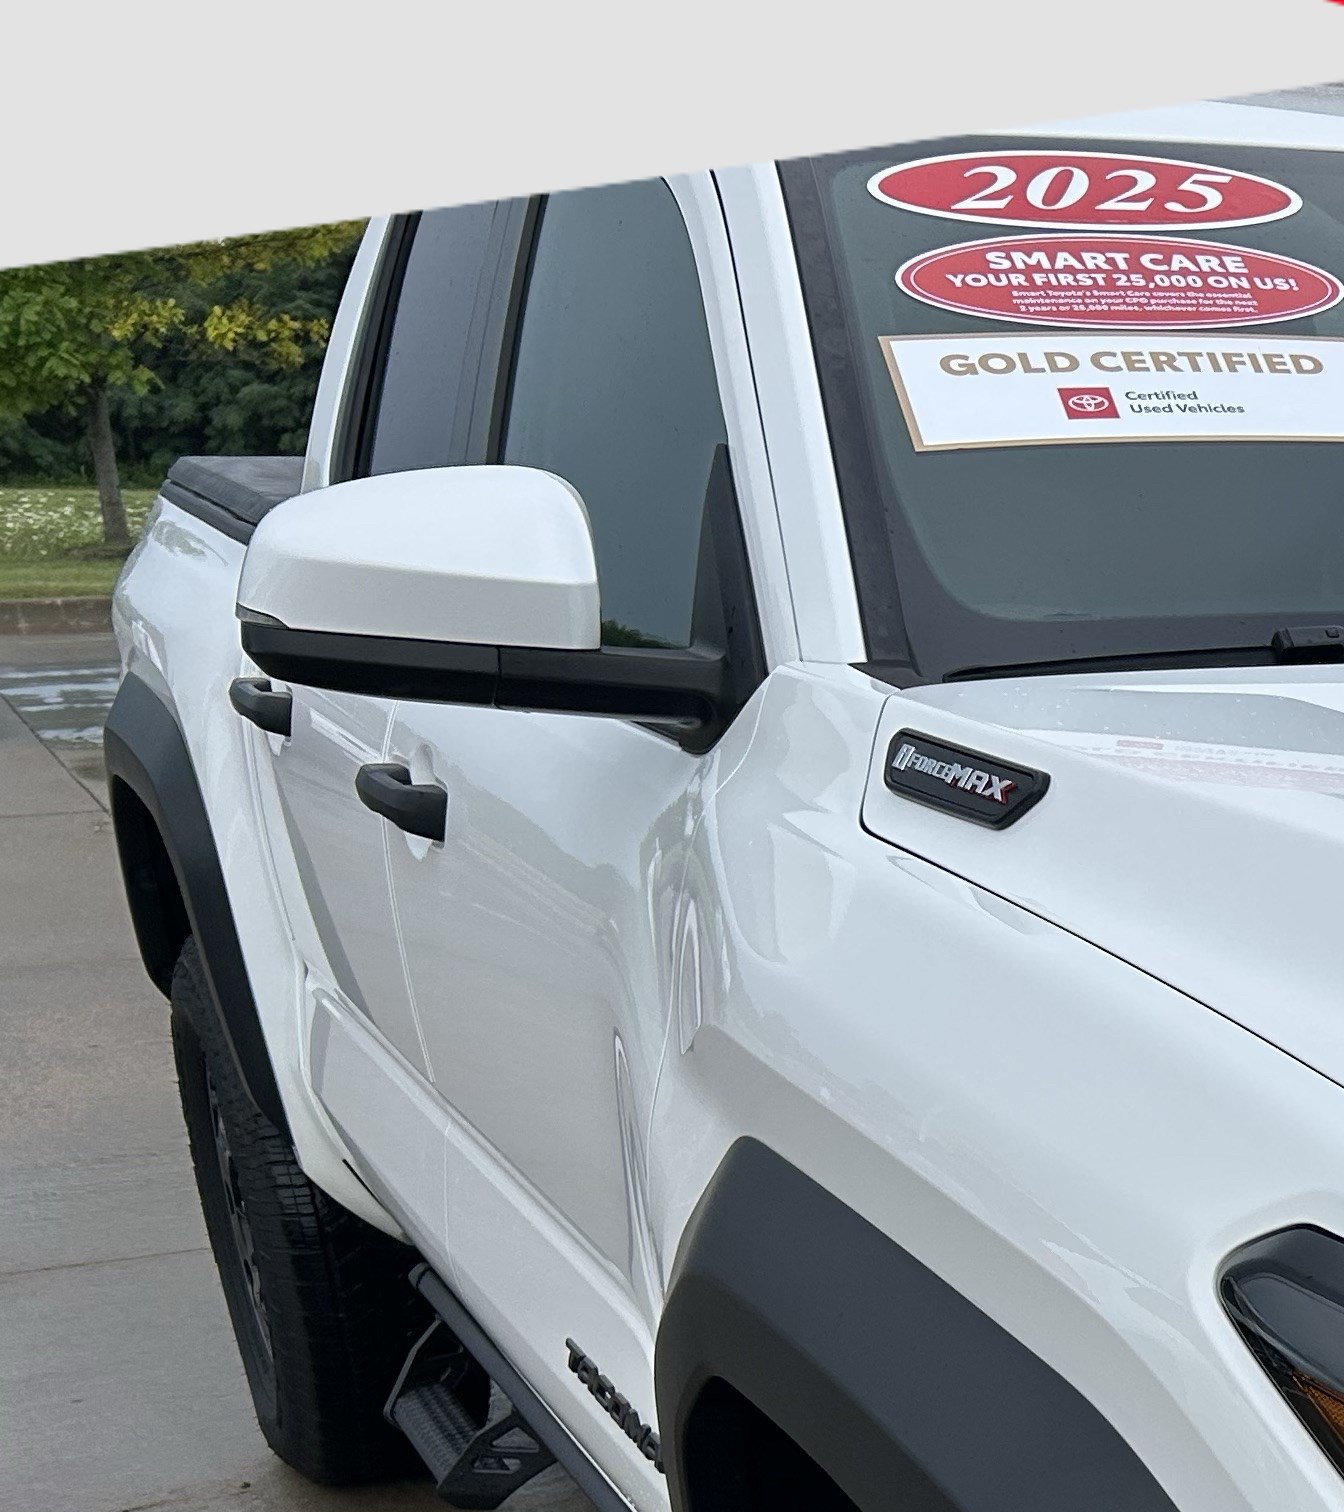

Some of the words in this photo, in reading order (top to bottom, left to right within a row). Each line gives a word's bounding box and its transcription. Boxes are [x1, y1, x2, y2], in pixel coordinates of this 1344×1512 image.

[950, 165, 1233, 213] 2025
[984, 251, 1130, 272] SMART
[1139, 253, 1250, 274] CARE
[945, 273, 1030, 288] YOUR
[1035, 273, 1114, 288] FIRST
[1114, 274, 1203, 289] 25,000
[1209, 276, 1251, 290] ON
[1255, 277, 1300, 292] US!
[938, 351, 1081, 376] GOLD
[1089, 350, 1325, 376] CERTIFIED
[1124, 390, 1199, 401] Certified
[1129, 403, 1174, 415] Used
[1175, 403, 1246, 415] Vehicles
